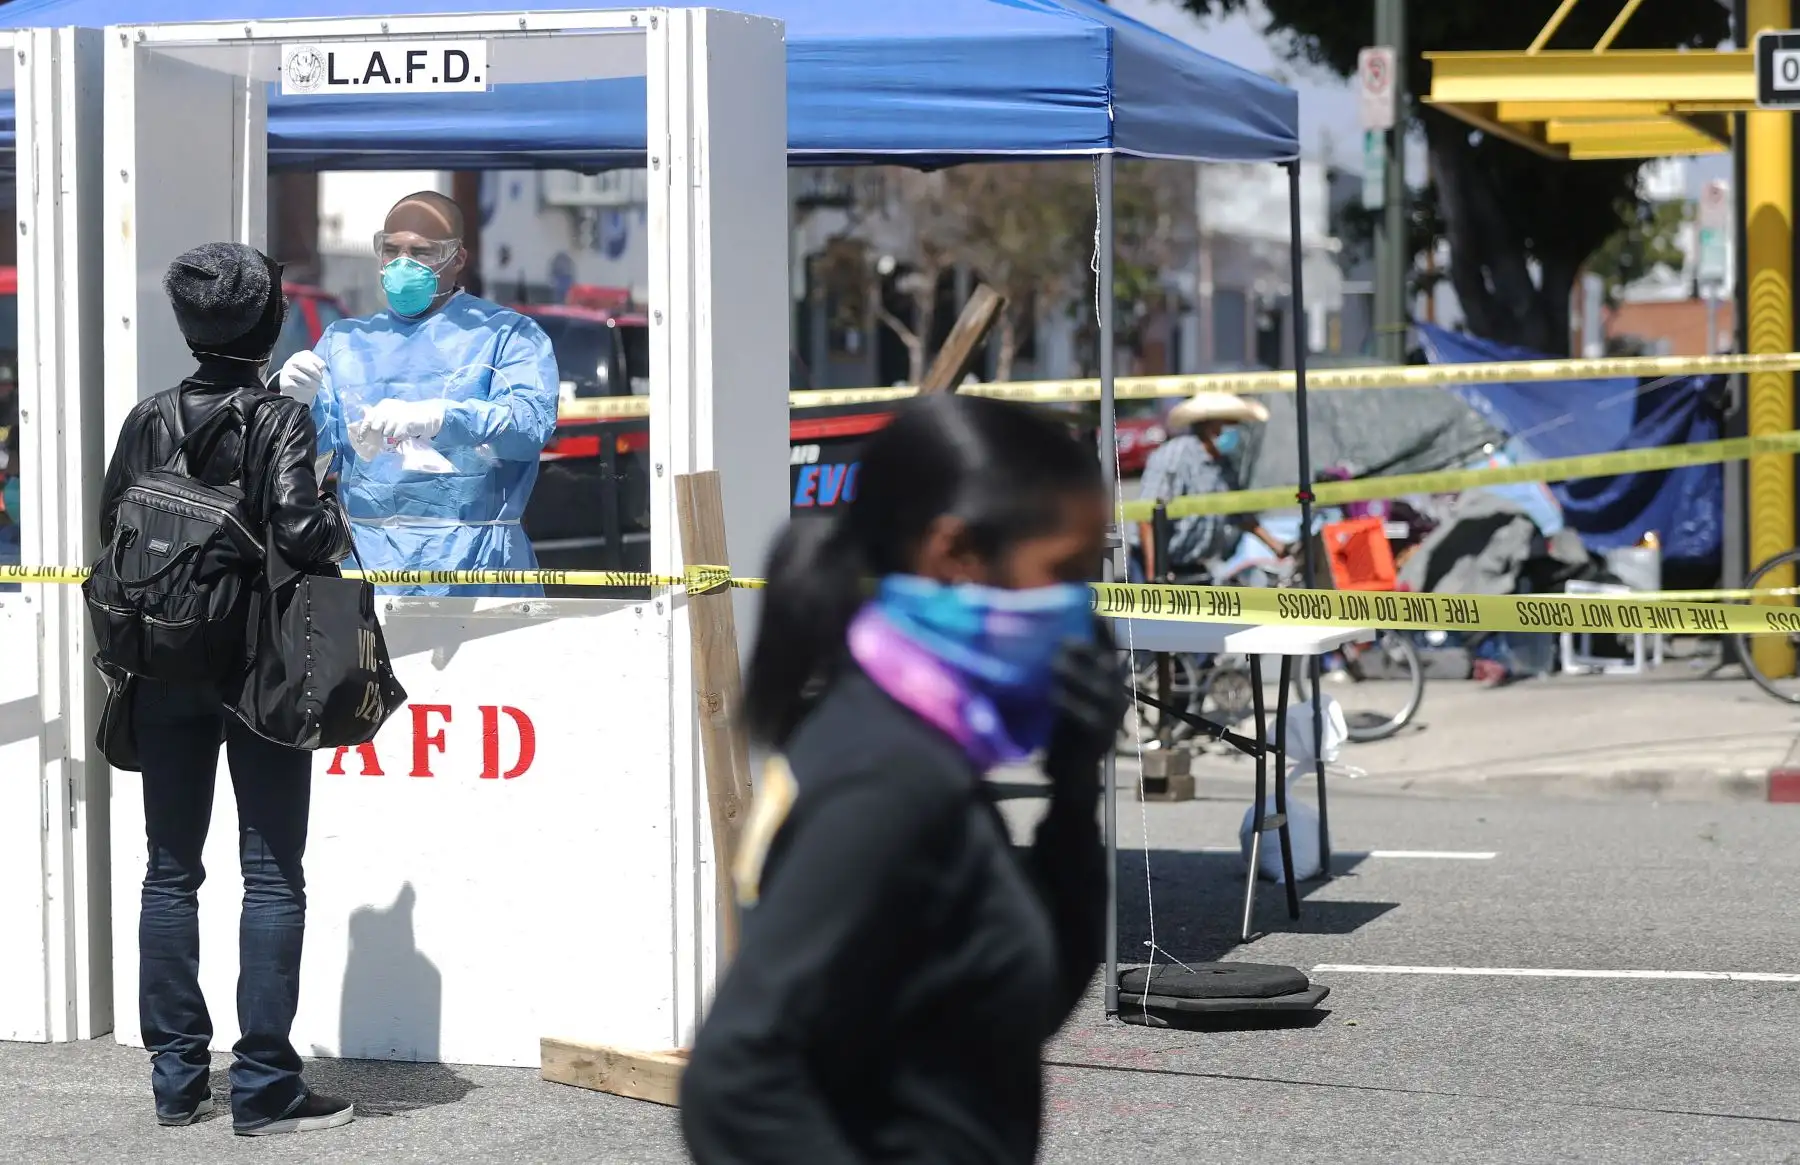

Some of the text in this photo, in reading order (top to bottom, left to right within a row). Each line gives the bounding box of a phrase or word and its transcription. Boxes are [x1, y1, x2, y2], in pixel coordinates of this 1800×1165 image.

[328, 50, 480, 84] L.A.F.D.
[1103, 587, 1135, 613] NOT
[1141, 588, 1162, 614] DO
[1165, 590, 1201, 616] LINE
[1205, 591, 1241, 617] FIRE
[1277, 593, 1480, 624] FIRE LINE DO NOT CROSS
[1516, 601, 1729, 630] FIRE LINE DO NOT CROSS
[1766, 611, 1800, 631] OSS
